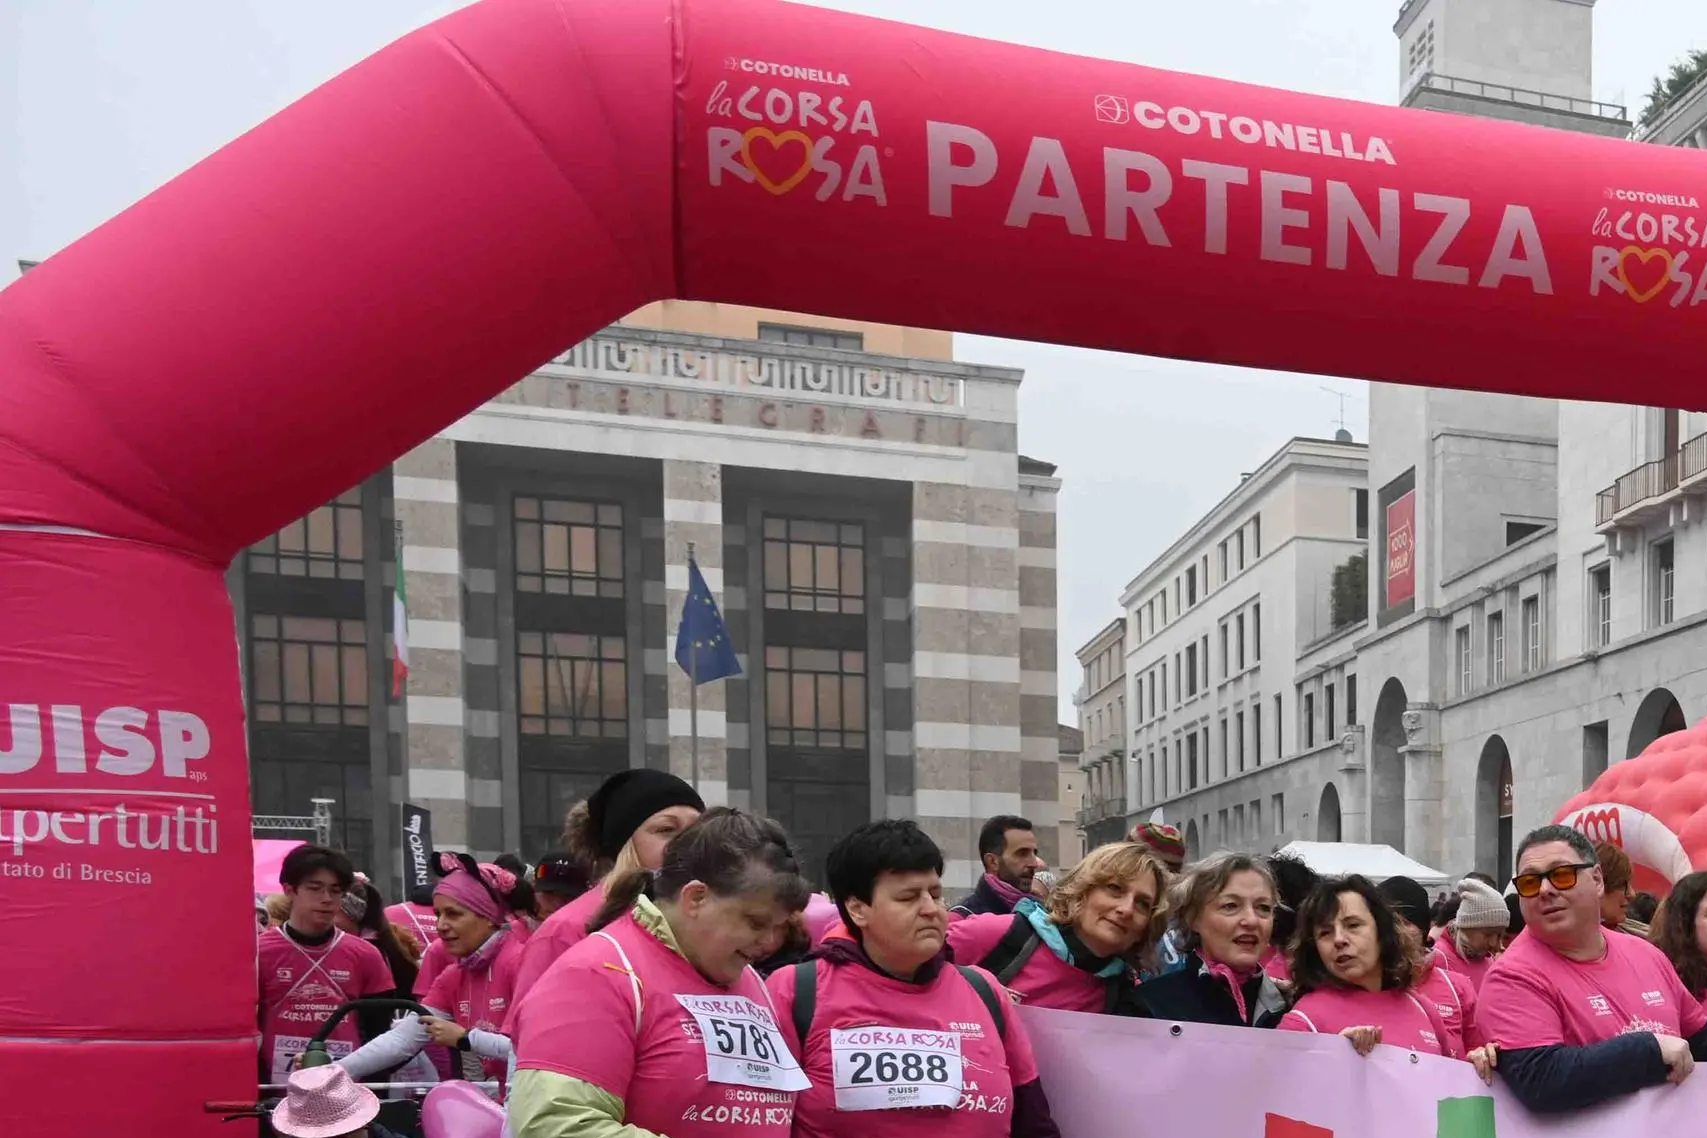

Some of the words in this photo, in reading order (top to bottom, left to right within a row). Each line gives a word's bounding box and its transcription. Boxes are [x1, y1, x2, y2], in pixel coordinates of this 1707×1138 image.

[741, 59, 850, 86] COTONELLA
[706, 80, 731, 118] la
[737, 86, 879, 137] CORSA
[1134, 101, 1397, 165] COTONELLA
[926, 119, 1553, 295] PARTENZA
[1616, 189, 1699, 208] COTONELLA
[1592, 207, 1612, 238] la
[189, 770, 208, 782] aps
[52, 862, 71, 880] di
[81, 863, 152, 885] Brescia
[695, 999, 746, 1015] CORSA
[709, 1018, 780, 1064] 5781
[847, 1032, 907, 1045] CORSA
[849, 1052, 949, 1084] 2688
[897, 1087, 919, 1095] UISP
[701, 1105, 762, 1126] CORSA
[988, 1096, 1007, 1114] 26
